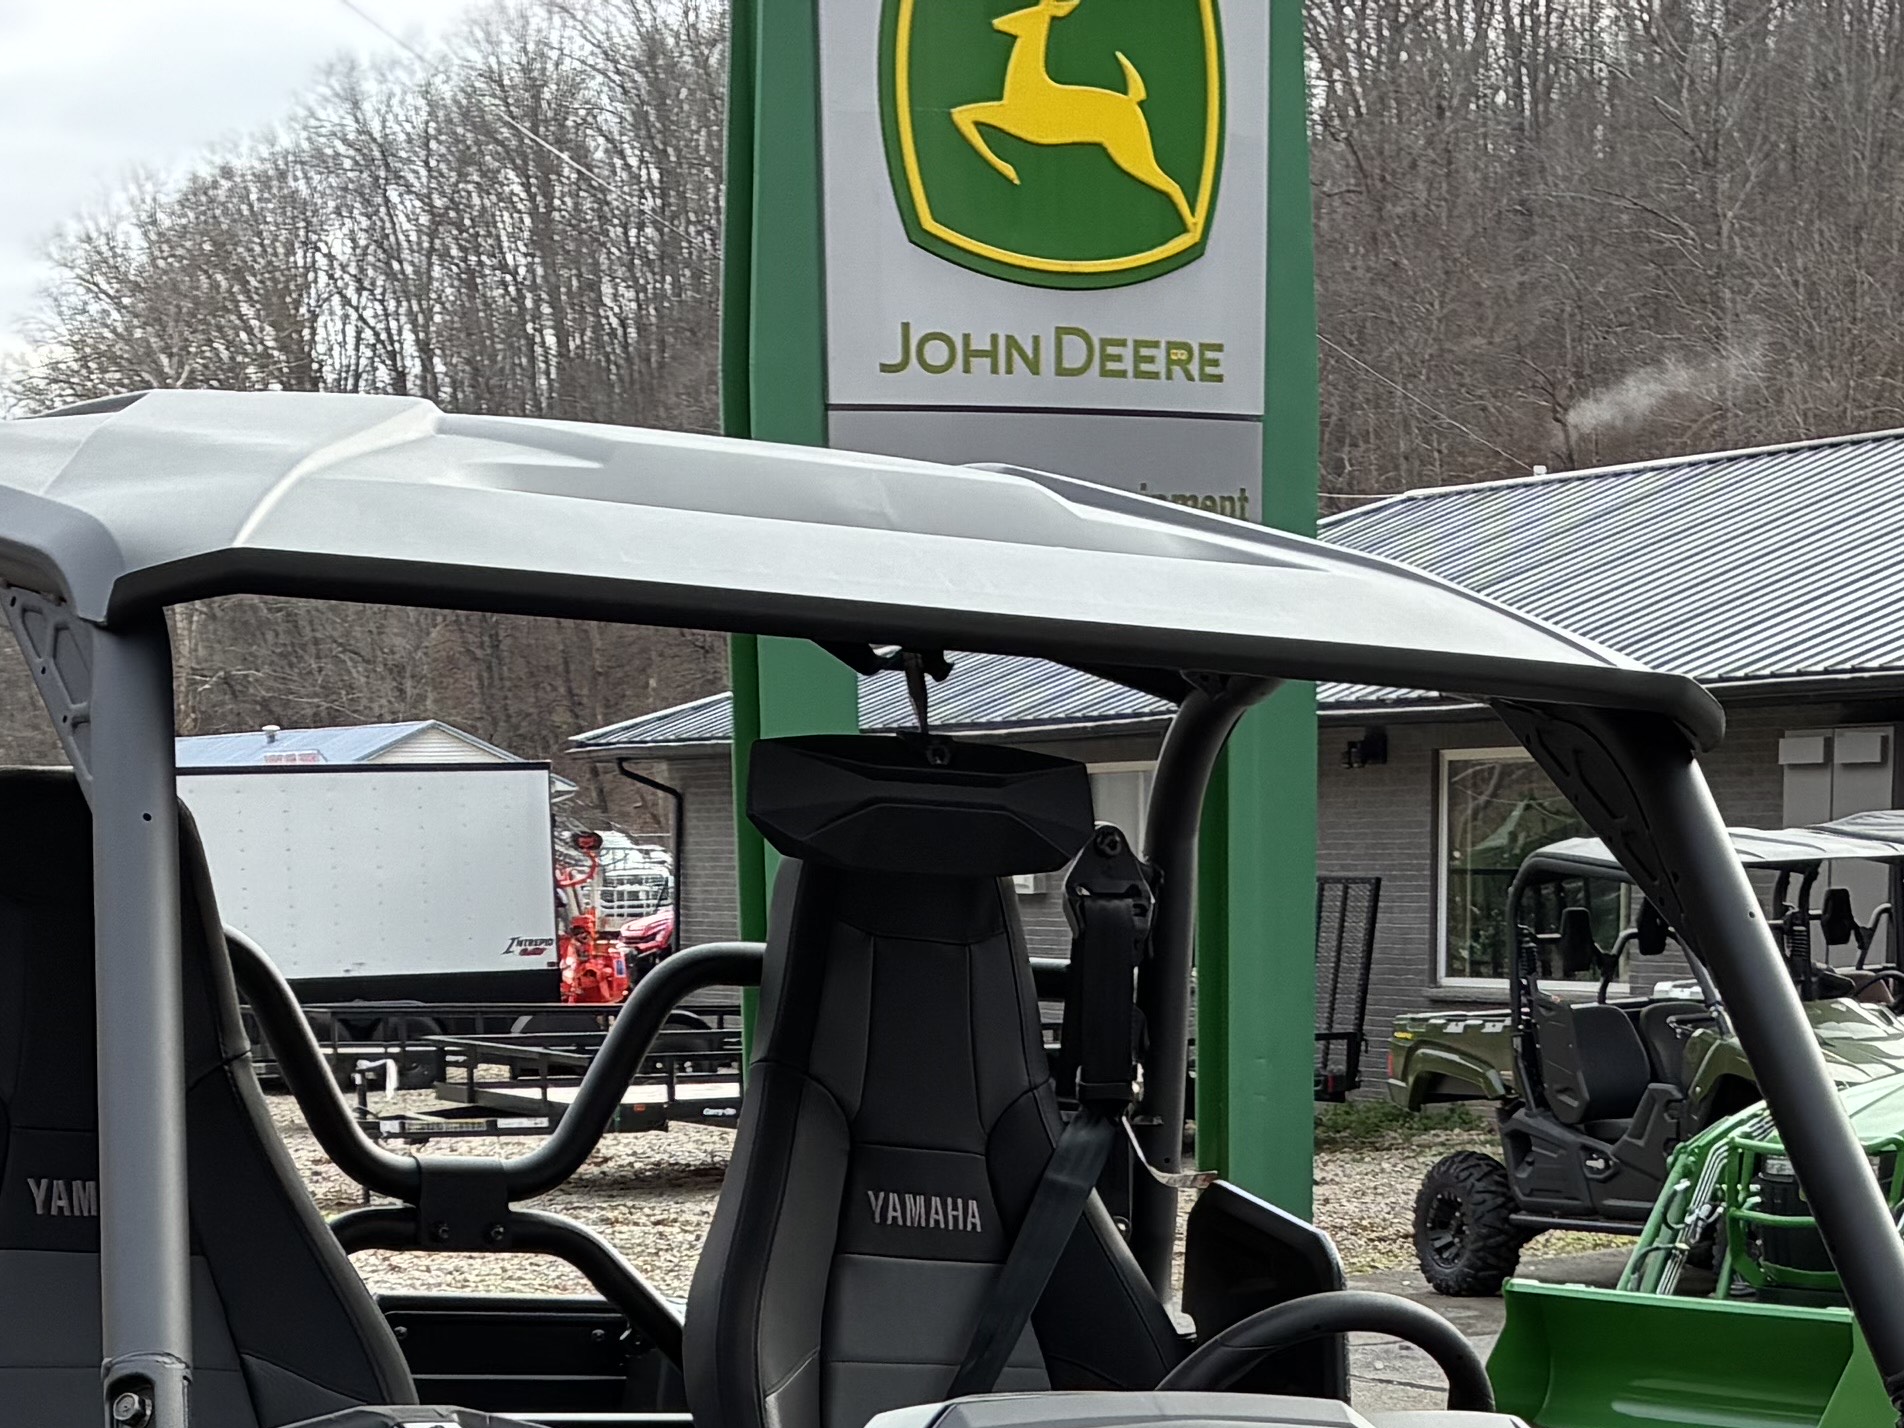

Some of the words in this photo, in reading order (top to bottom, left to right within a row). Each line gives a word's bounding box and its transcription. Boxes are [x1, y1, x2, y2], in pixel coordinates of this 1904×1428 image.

[879, 321, 1040, 377] JOHN
[1054, 326, 1225, 384] DEERE
[27, 1178, 97, 1216] YAM
[867, 1190, 981, 1232] YAMAHA
